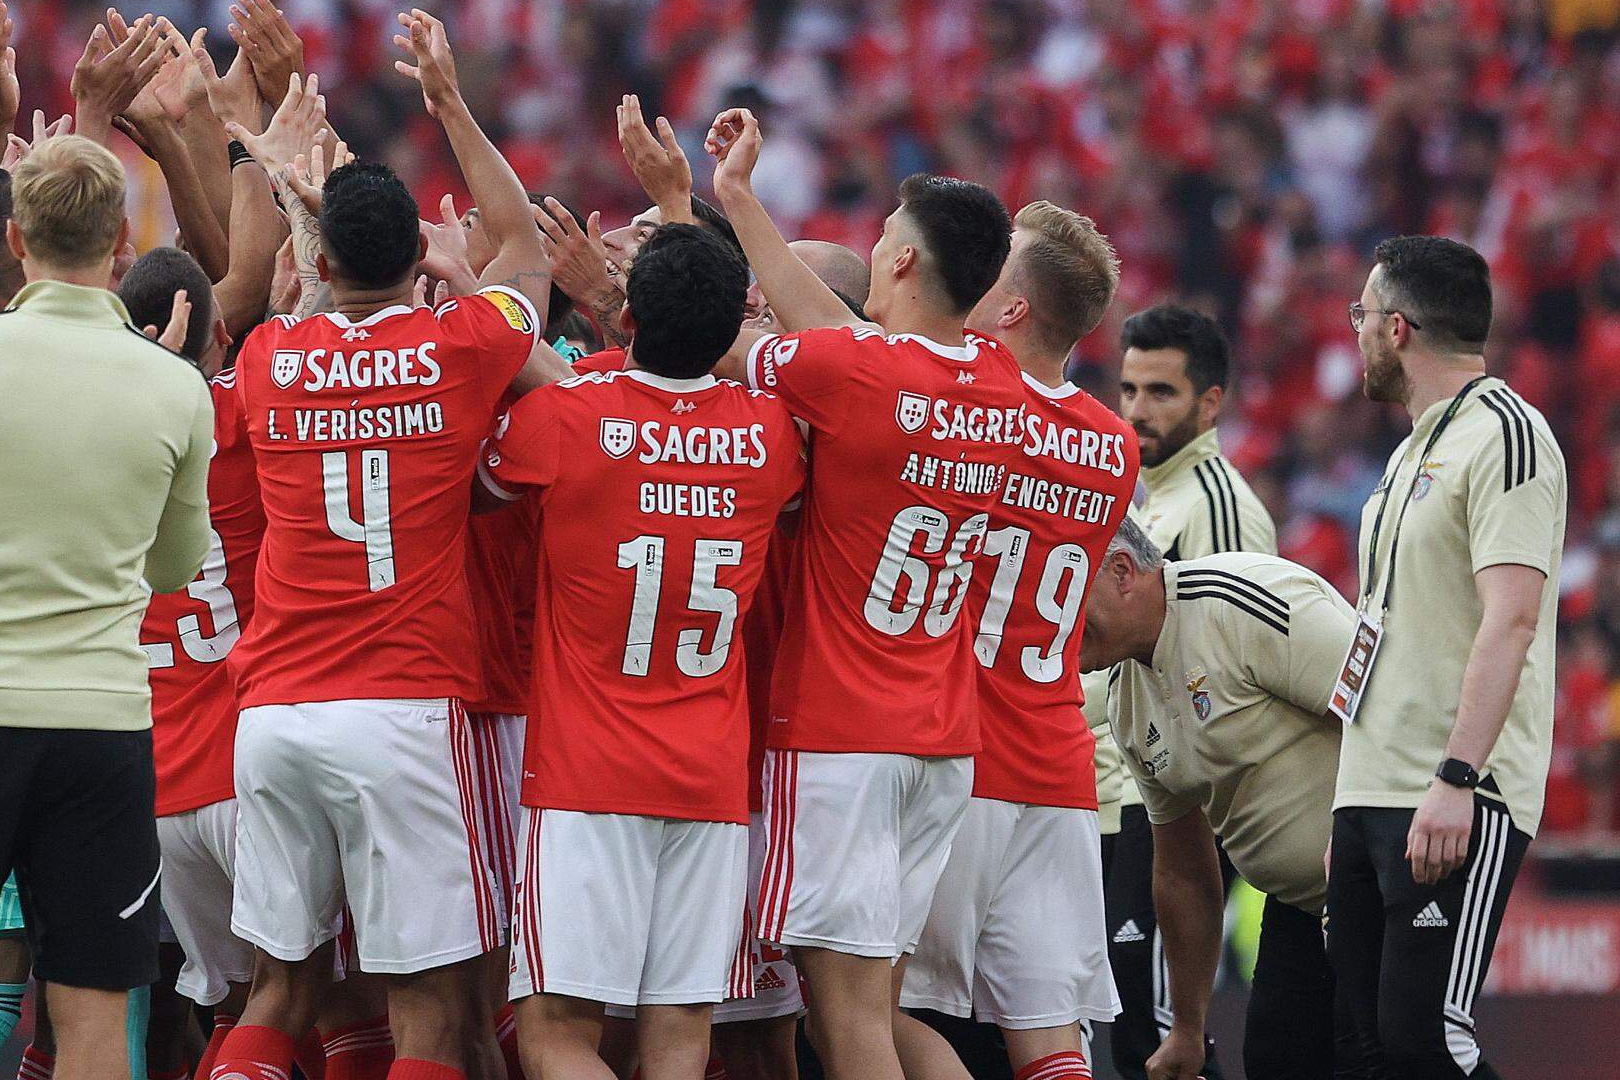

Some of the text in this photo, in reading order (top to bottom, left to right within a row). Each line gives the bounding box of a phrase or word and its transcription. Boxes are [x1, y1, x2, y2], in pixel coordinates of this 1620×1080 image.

[303, 341, 441, 392] SAGRES
[764, 338, 777, 387] TANO
[268, 399, 444, 441] L. VERÍSSIMO
[638, 420, 767, 468] SAGRES
[1023, 413, 1125, 478] SAGRES
[322, 449, 396, 593] 4
[640, 482, 737, 518] GUEDES
[138, 528, 242, 669] 3
[617, 535, 743, 678] 15
[973, 526, 1089, 683] 19
[1413, 918, 1449, 928] adidas
